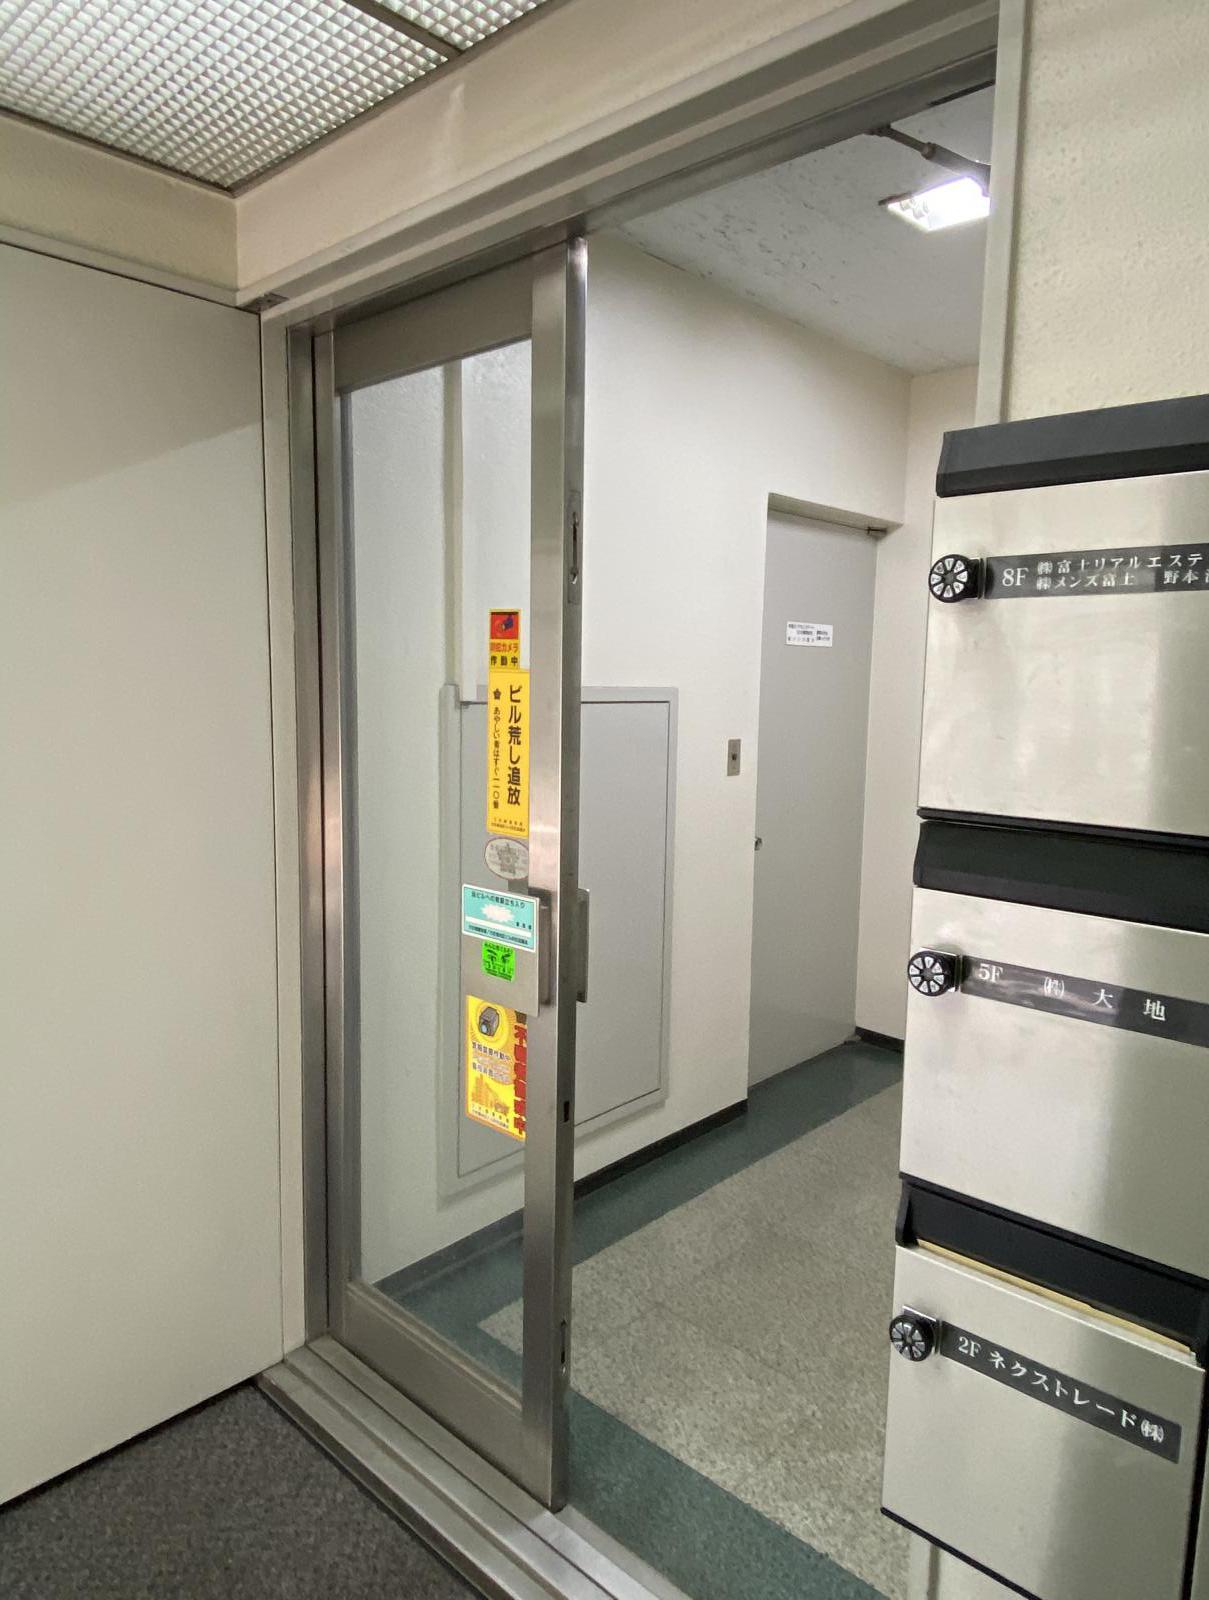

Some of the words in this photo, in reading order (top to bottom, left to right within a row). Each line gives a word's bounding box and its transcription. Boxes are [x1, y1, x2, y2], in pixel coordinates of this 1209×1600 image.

[1002, 567, 1028, 587] 8F
[507, 684, 522, 806] ビル荒し追放
[978, 963, 1003, 983] 5F
[958, 1336, 982, 1357] 2F
